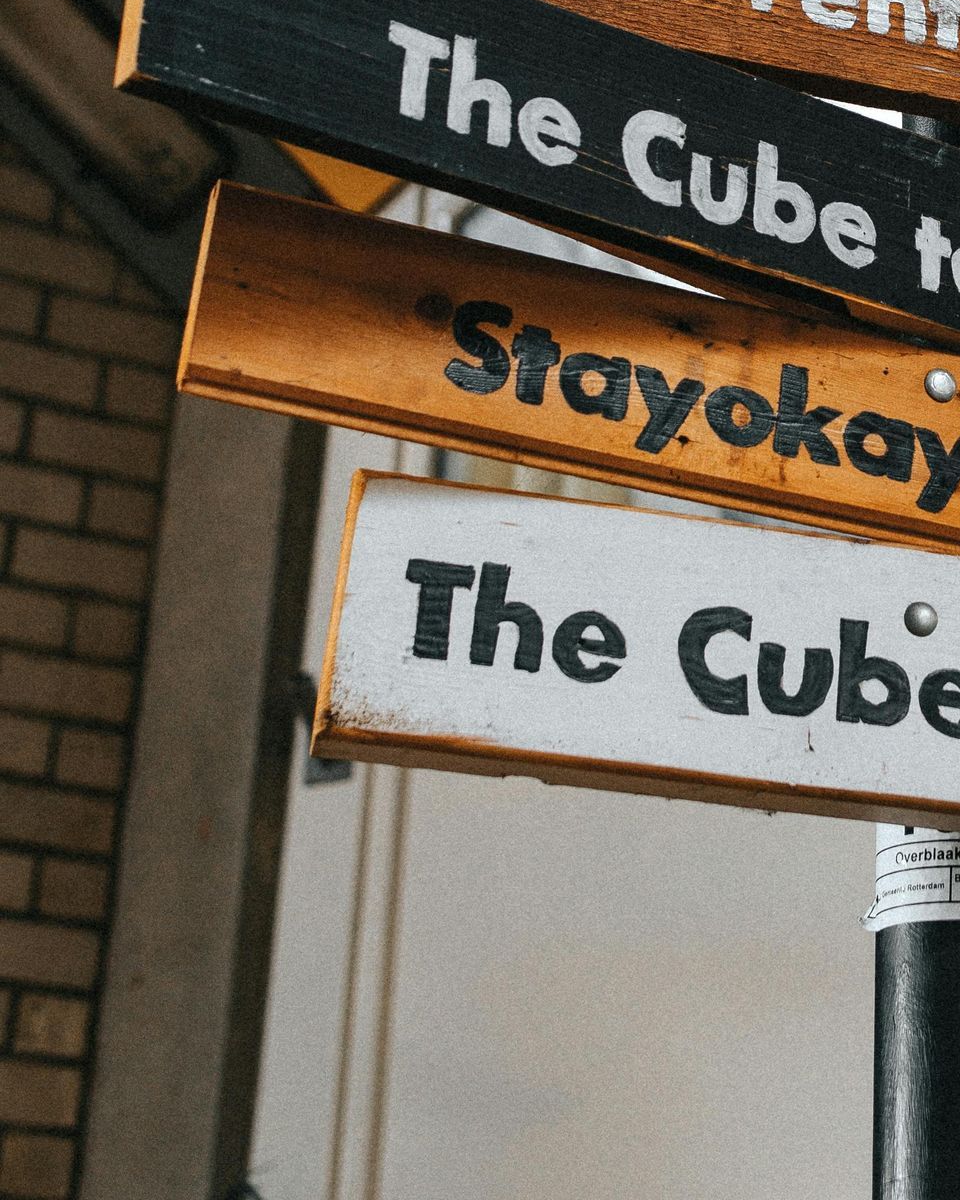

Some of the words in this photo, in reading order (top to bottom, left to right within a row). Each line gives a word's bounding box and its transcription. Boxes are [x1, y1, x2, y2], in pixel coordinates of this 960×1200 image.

[387, 19, 582, 166] The
[621, 108, 877, 270] Cube
[405, 558, 628, 683] The
[907, 882, 945, 892] Rotterdam
